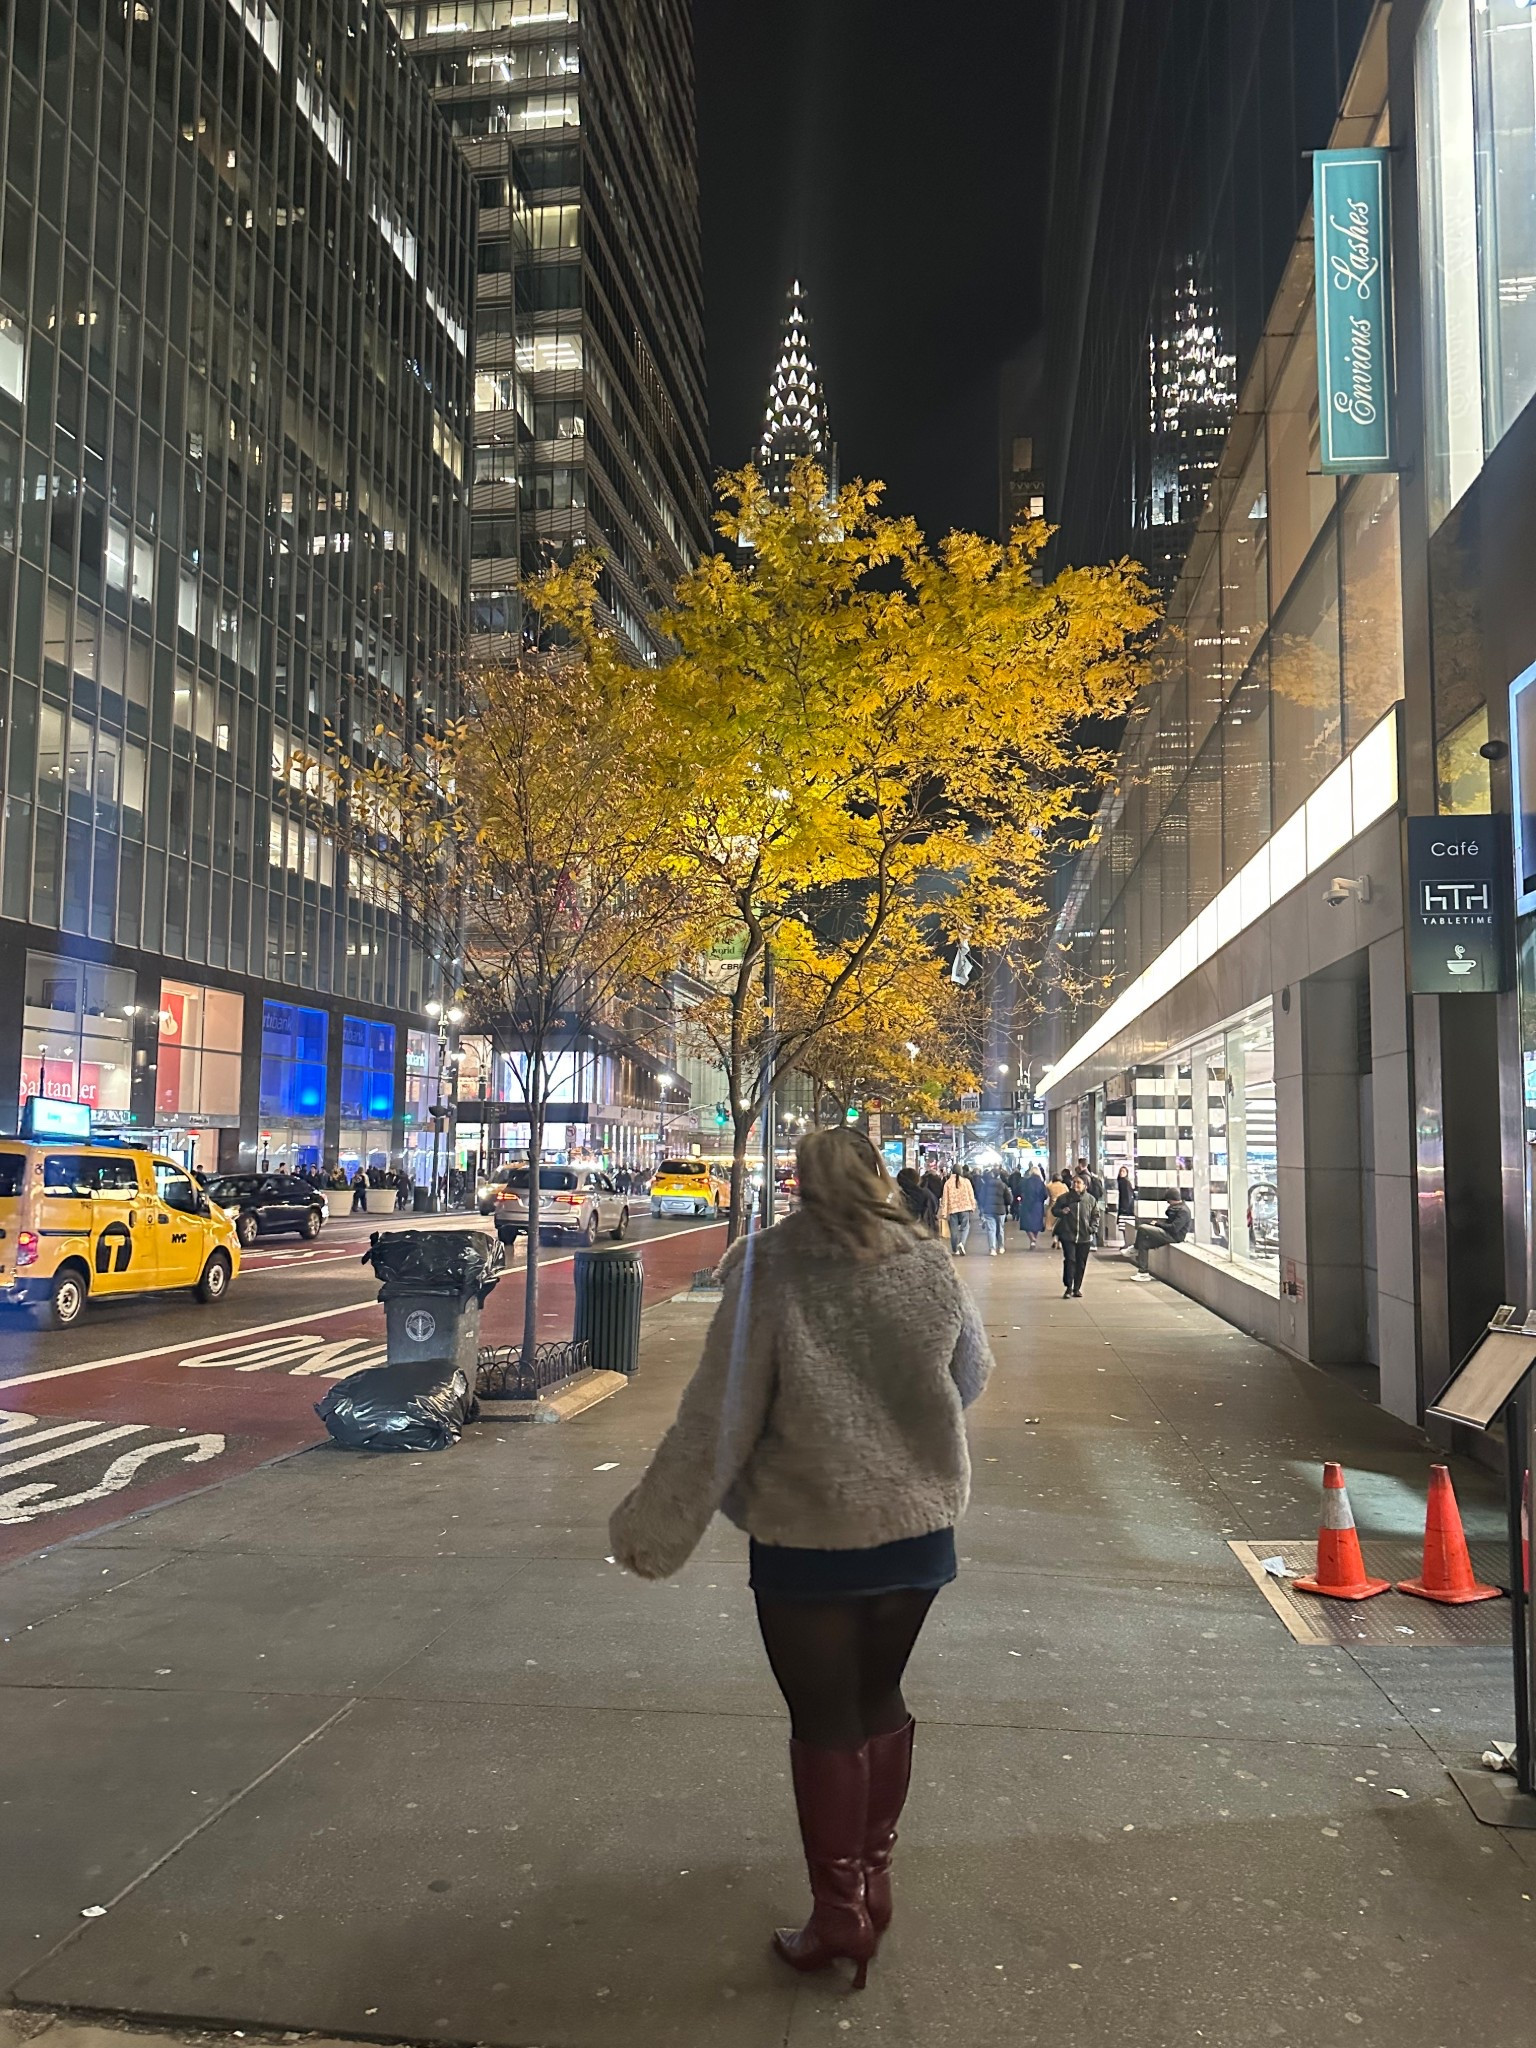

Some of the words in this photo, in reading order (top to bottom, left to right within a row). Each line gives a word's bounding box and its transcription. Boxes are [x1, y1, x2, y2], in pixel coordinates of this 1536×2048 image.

[1330, 197, 1379, 300] Lashes
[1334, 315, 1377, 426] Envious
[1430, 840, 1479, 857] Café
[1422, 916, 1493, 925] TABLETIME
[20, 1072, 97, 1100] Sataner
[171, 1233, 188, 1244] NYC
[178, 1334, 388, 1380] ON
